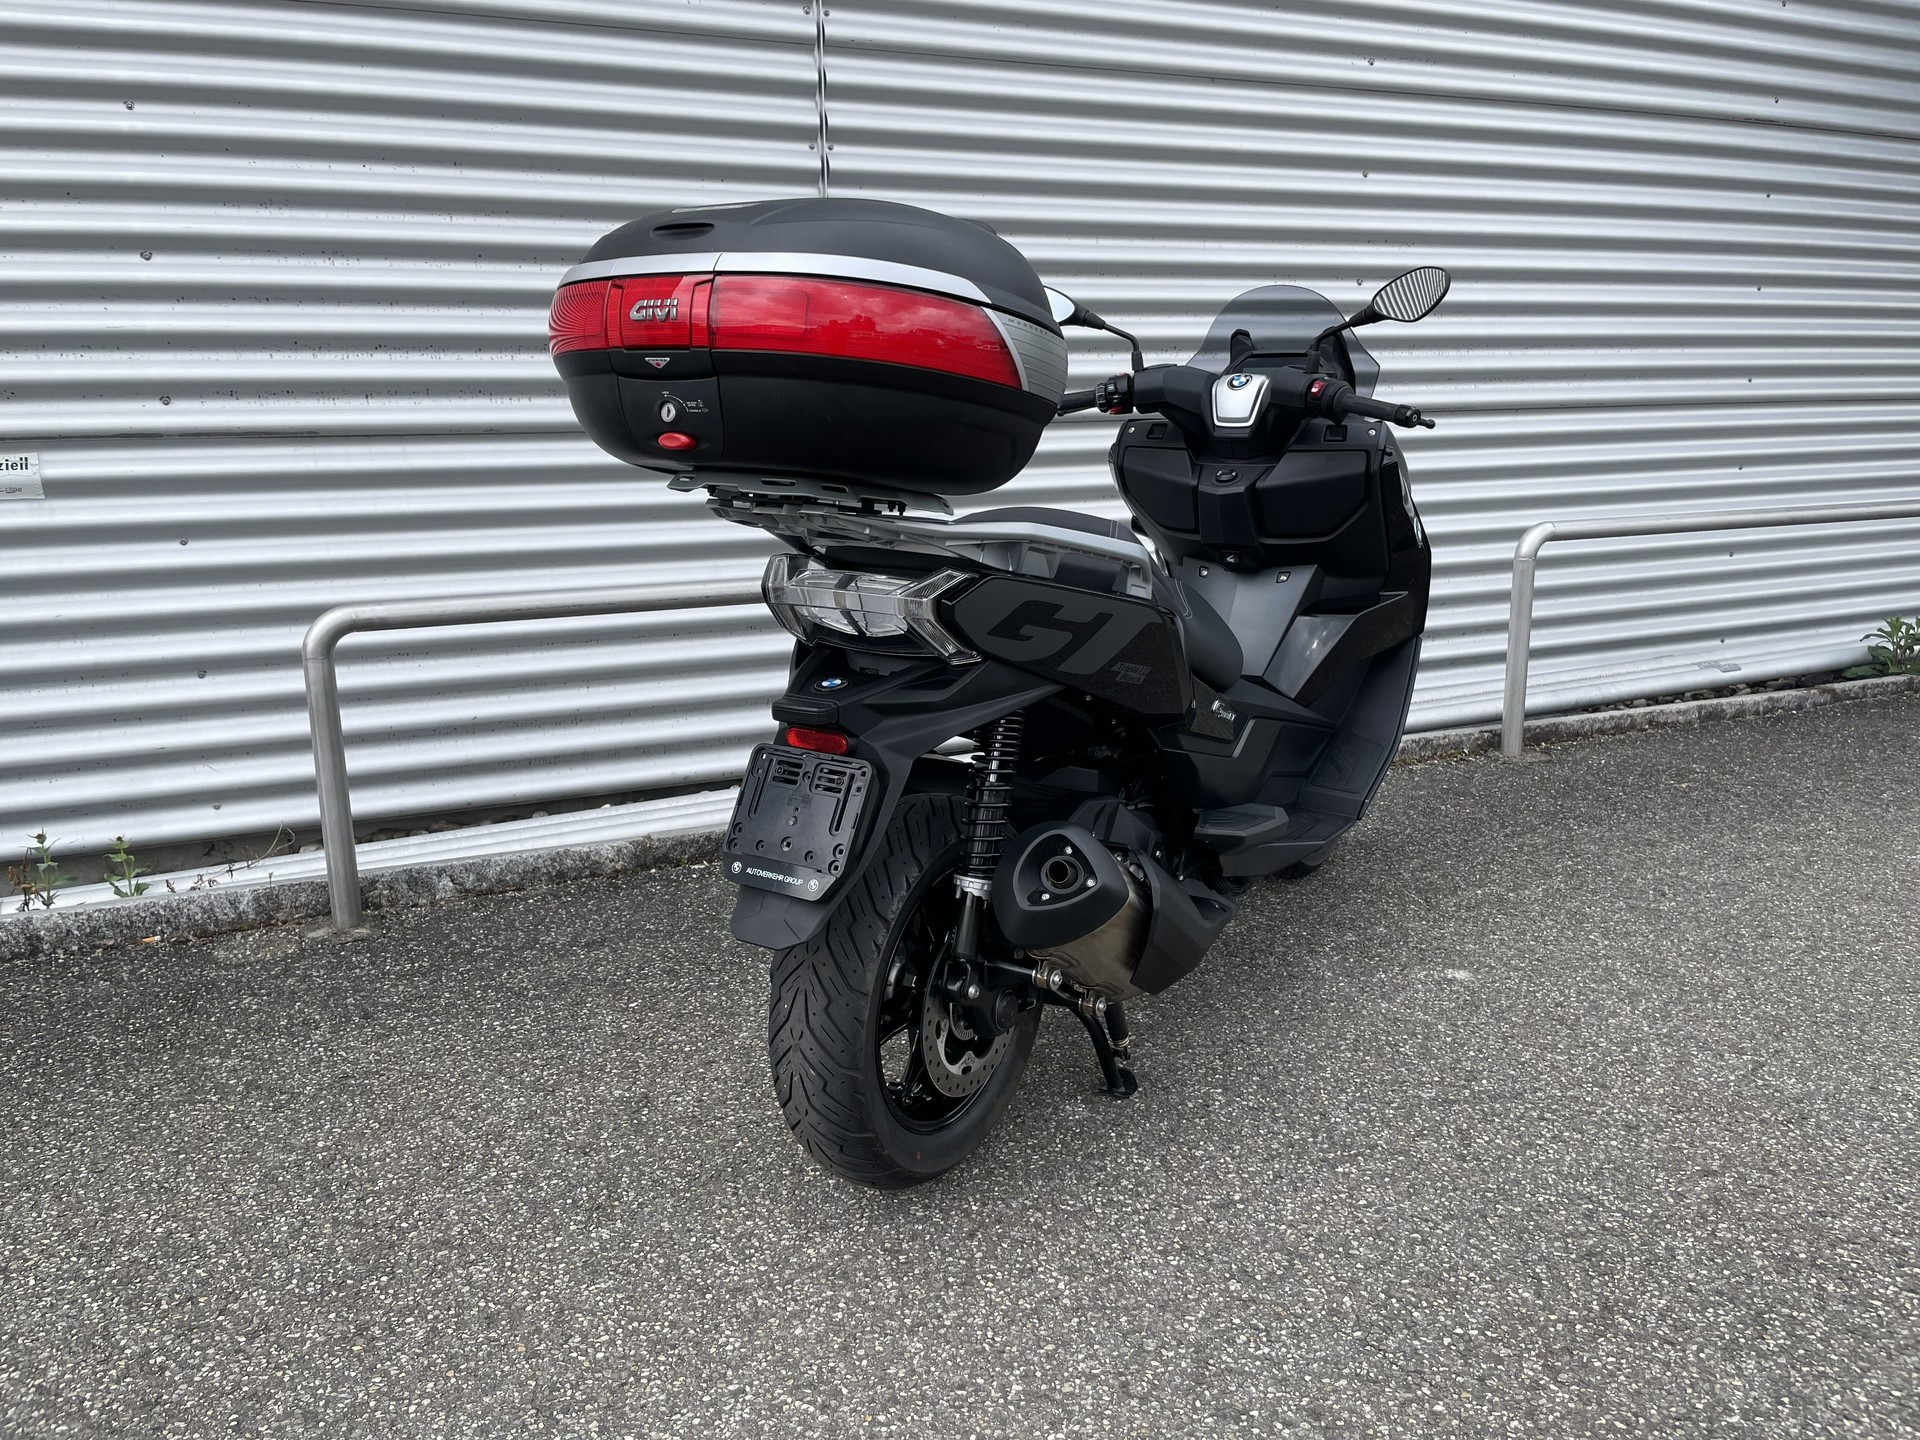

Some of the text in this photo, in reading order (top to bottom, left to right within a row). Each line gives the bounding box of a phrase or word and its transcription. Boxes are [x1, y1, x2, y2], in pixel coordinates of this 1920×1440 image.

[629, 298, 679, 322] GIVI
[745, 866, 804, 886] AUTOVERKEHR GROUP
